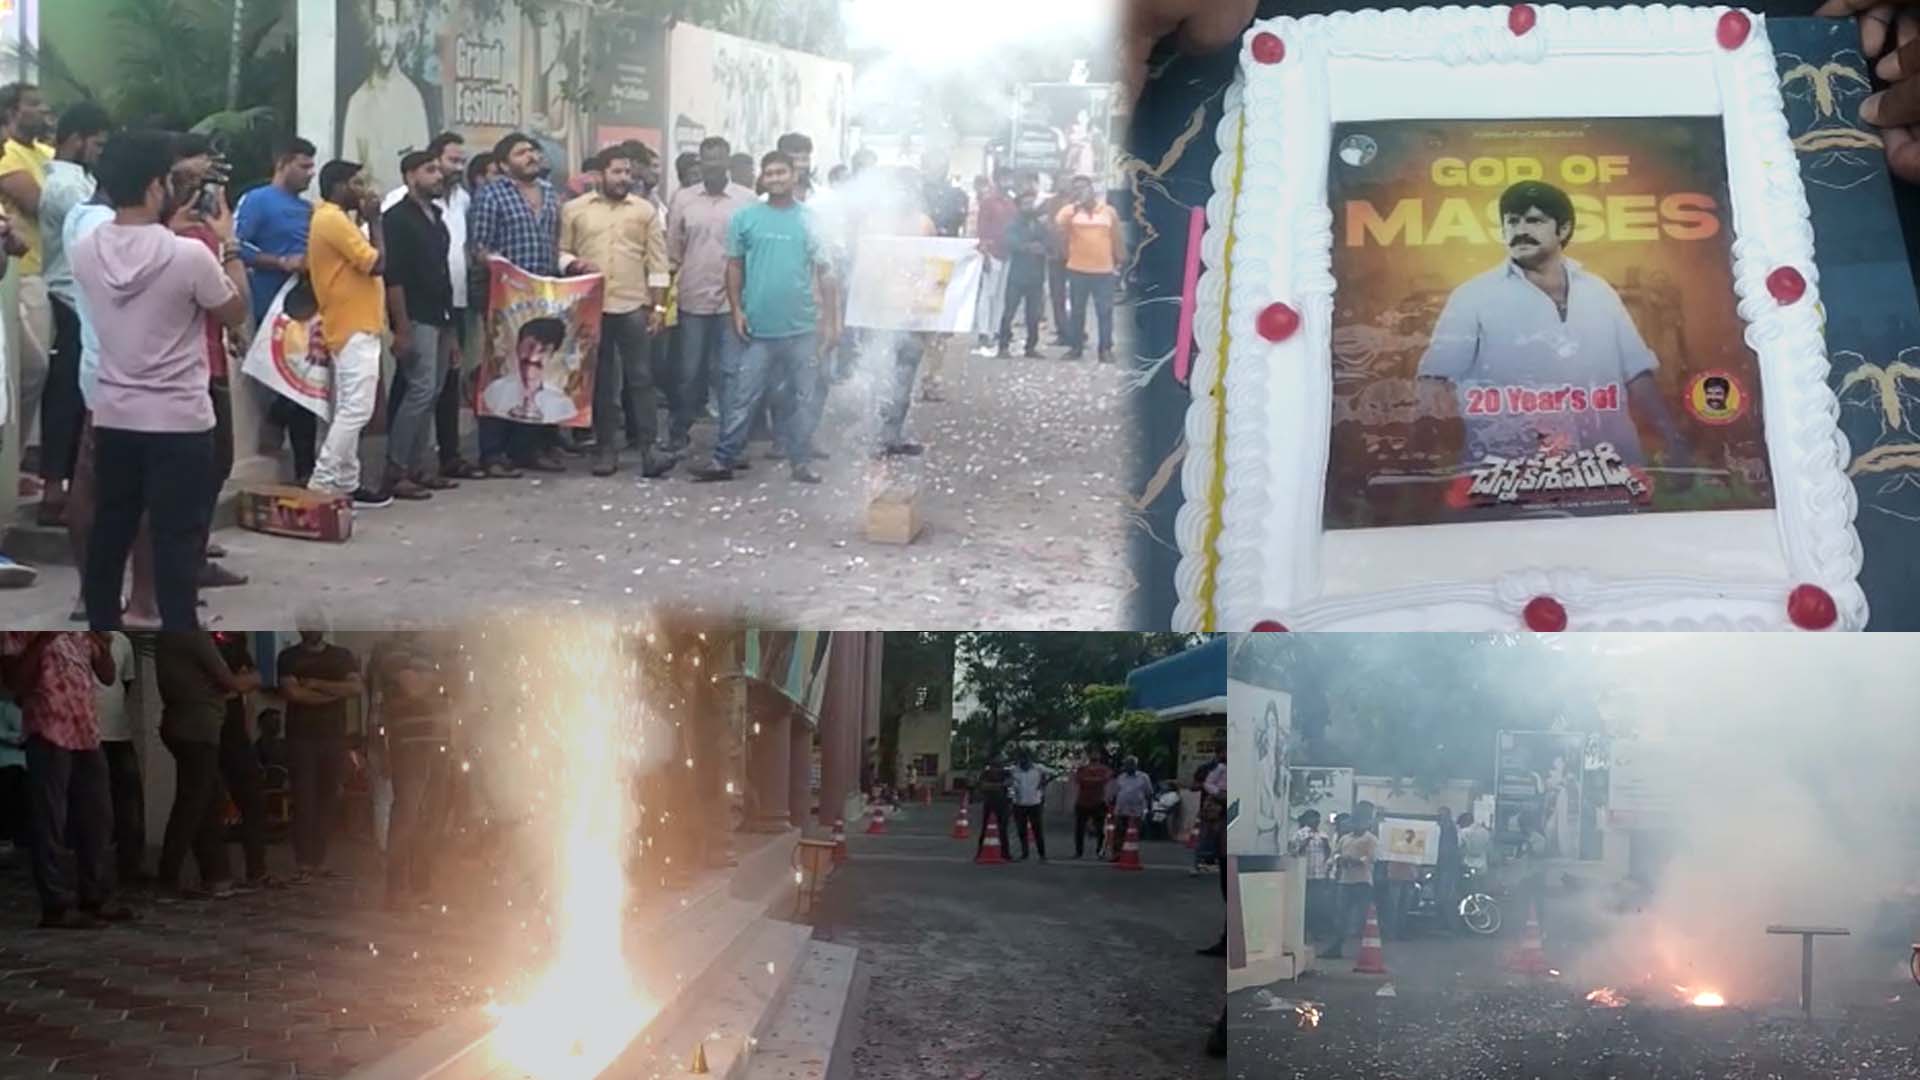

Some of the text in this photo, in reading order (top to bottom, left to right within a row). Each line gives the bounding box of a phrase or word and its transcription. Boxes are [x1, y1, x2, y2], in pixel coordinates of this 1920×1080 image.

[455, 36, 501, 79] Grand
[455, 81, 519, 125] Festivals
[1431, 154, 1631, 187] GOD OF
[1466, 383, 1619, 415] 20 Year's of
